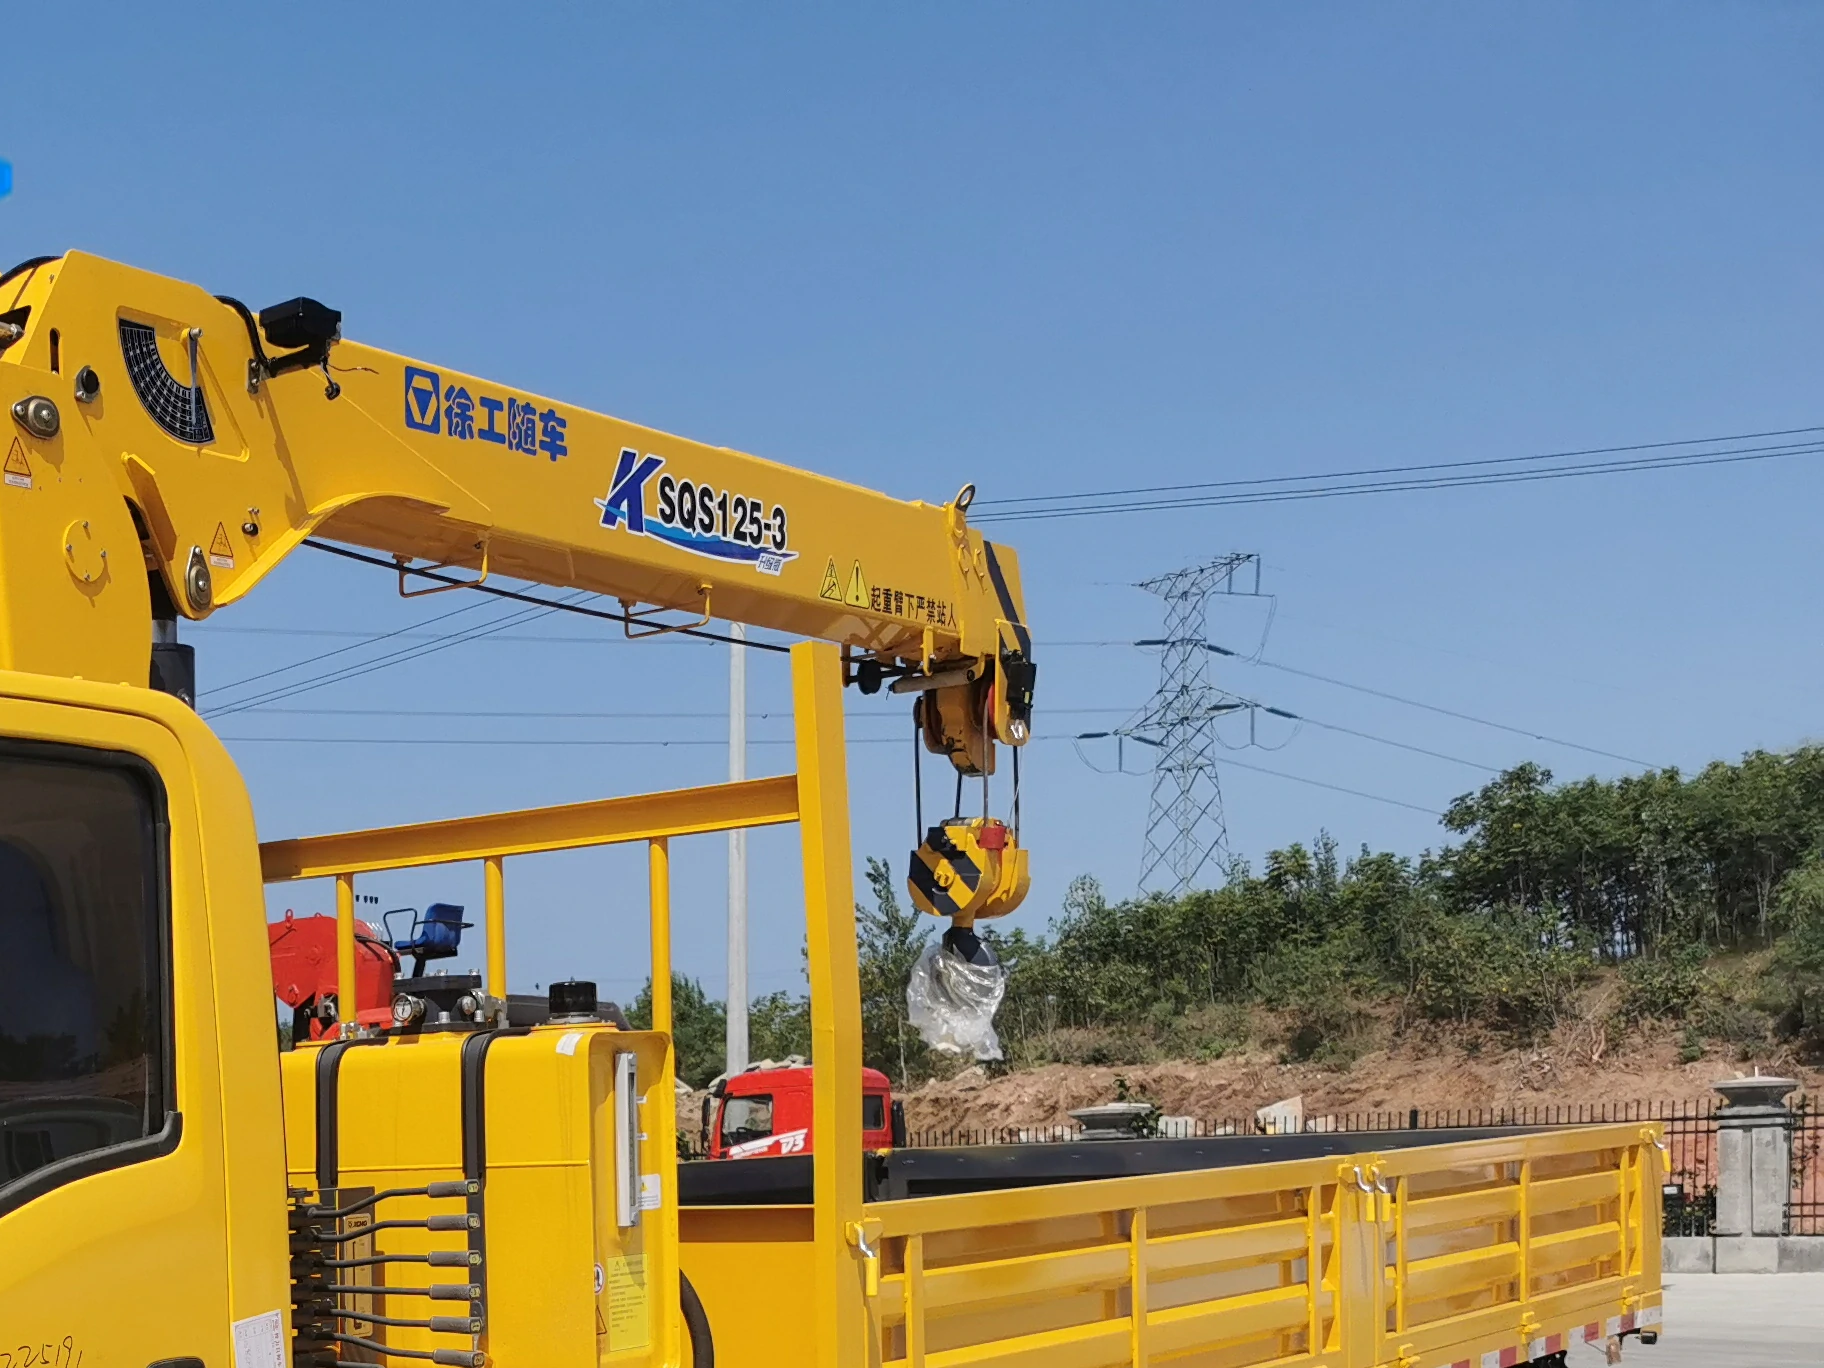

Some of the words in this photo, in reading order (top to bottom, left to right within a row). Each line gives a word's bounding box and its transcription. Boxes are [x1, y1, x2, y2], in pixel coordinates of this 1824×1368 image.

[443, 385, 568, 462] 徐工随车
[658, 474, 788, 551] SQS125-3
[870, 584, 957, 629] 起重臂下严禁站人
